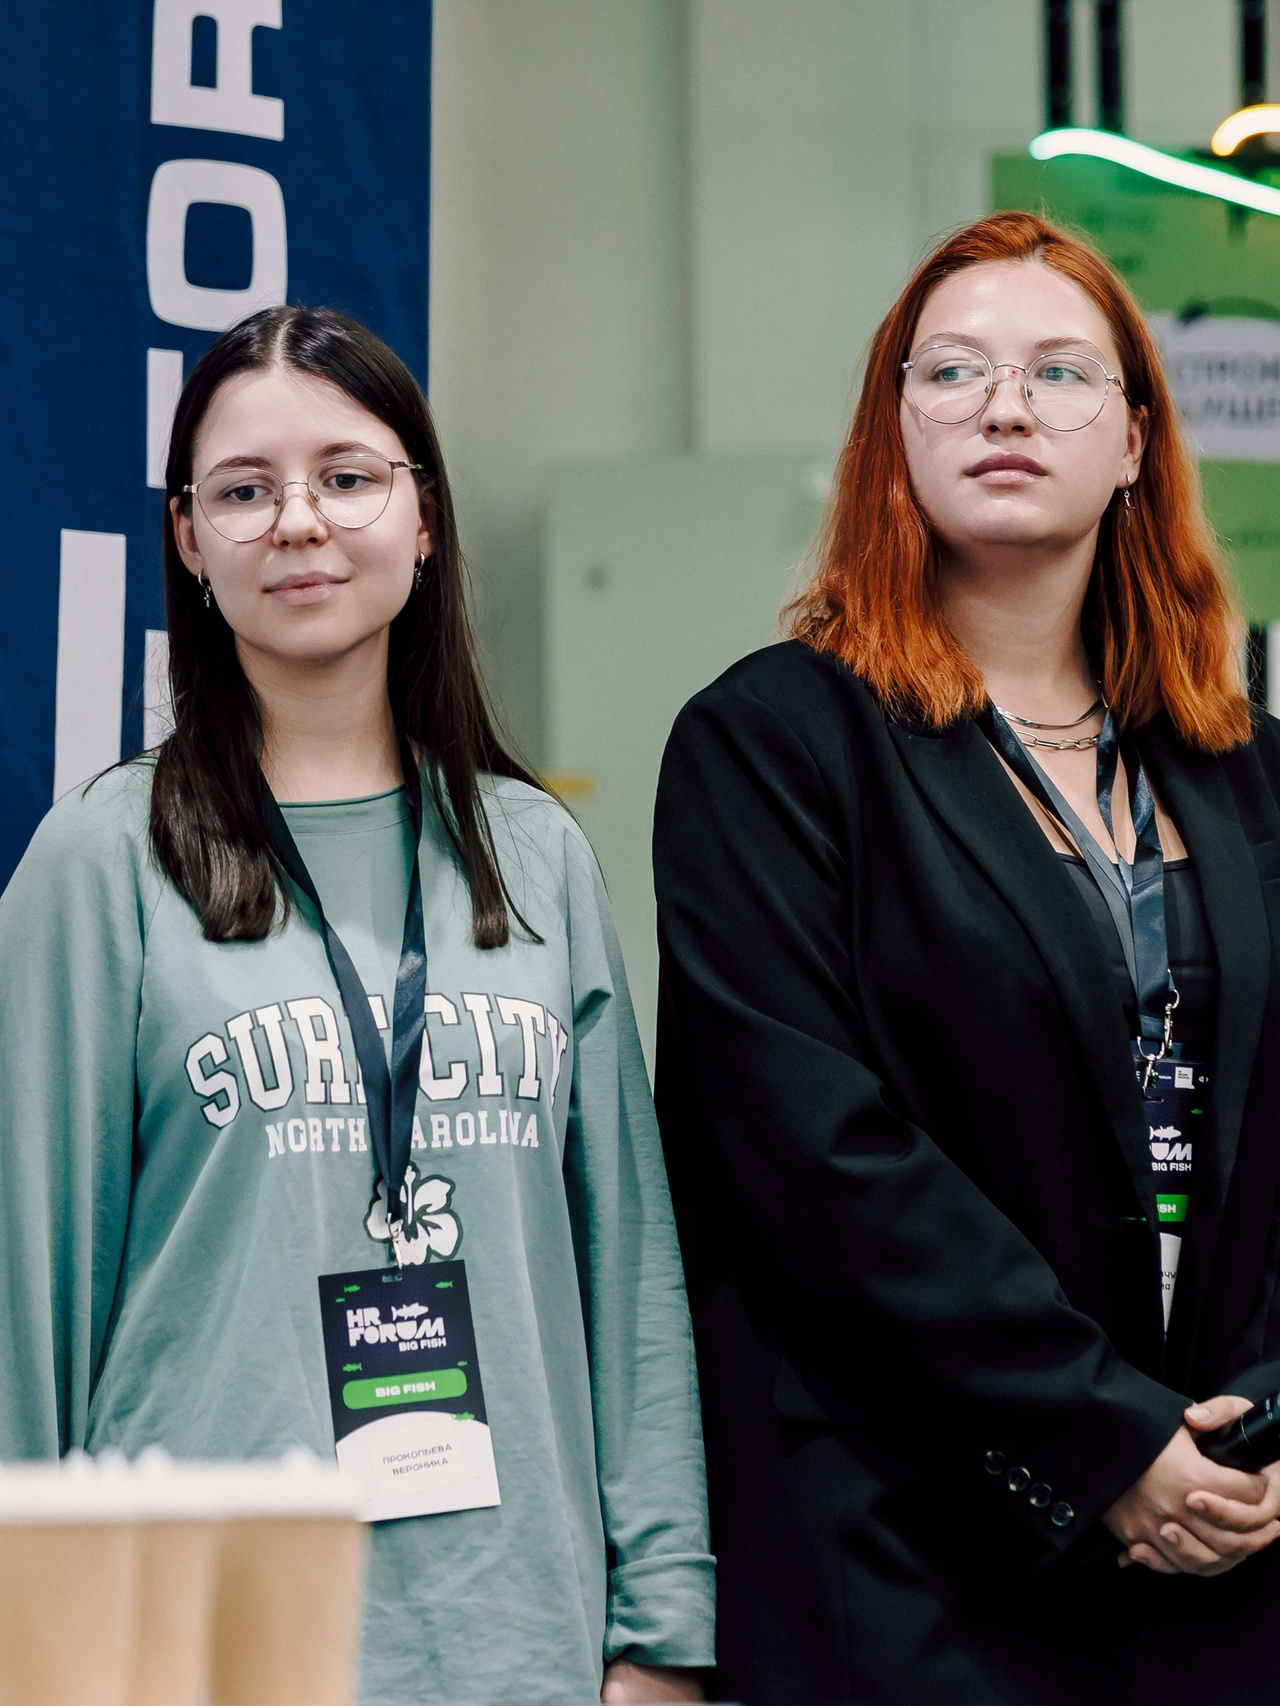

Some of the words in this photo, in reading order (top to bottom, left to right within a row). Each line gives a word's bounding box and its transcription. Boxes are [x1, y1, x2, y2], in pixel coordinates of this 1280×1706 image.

[264, 1116, 368, 1159] NORTH
[410, 1109, 540, 1149] AROLINA
[1151, 1162, 1167, 1171] BIG
[1169, 1162, 1191, 1171] FISH
[346, 1306, 381, 1328] HR
[348, 1316, 445, 1347] FORUM
[398, 1340, 418, 1351] BIG
[420, 1336, 446, 1349] FISH
[375, 1384, 400, 1398] BIG
[403, 1380, 436, 1395] FISH
[382, 1443, 452, 1465] ПРОКОПЬЕВА
[391, 1456, 449, 1476] ВЕРОНИКА
